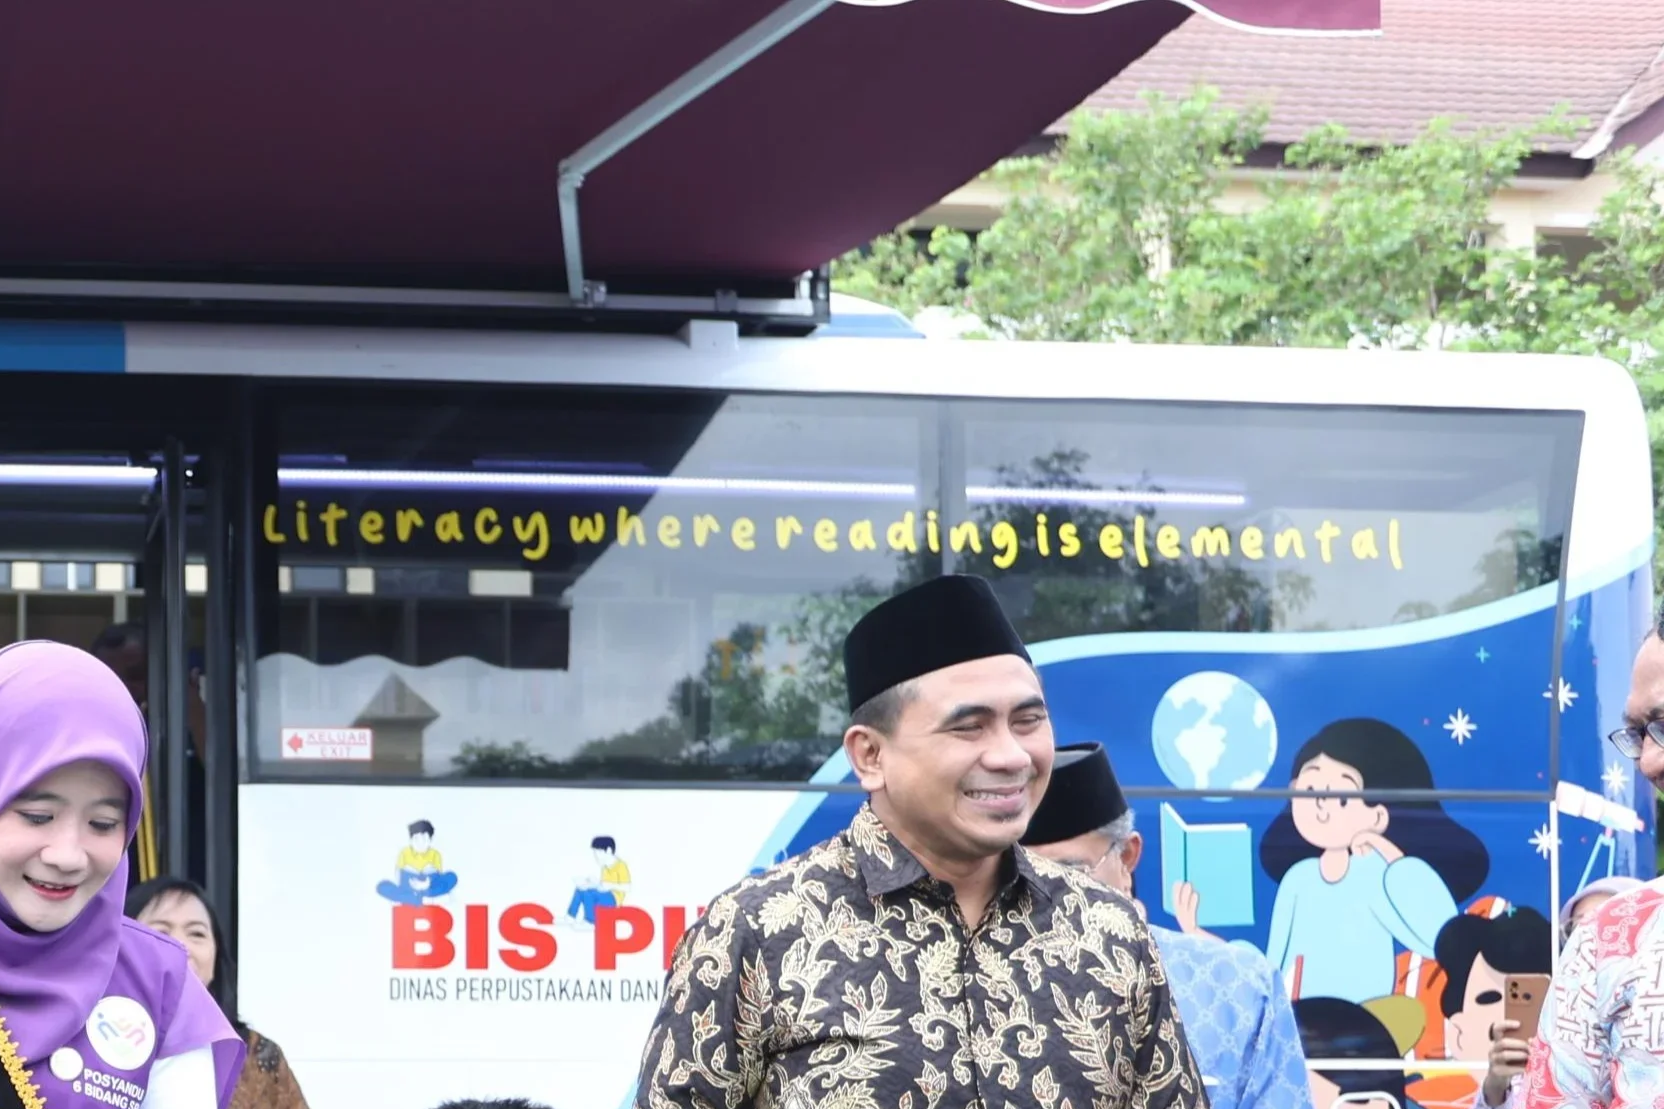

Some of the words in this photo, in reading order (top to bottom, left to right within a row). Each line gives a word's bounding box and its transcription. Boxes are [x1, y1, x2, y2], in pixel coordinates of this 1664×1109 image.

[262, 501, 550, 560] Literacy
[569, 506, 756, 551] where
[775, 511, 1019, 568] reading
[1036, 513, 1081, 557] is
[1098, 514, 1403, 569] elemental
[307, 731, 367, 743] KELUAR
[320, 746, 352, 758] EXIT
[392, 902, 558, 972] BIS
[594, 905, 707, 971] PI
[389, 977, 448, 1001] DINAS
[456, 977, 612, 1002] PERPUSTAKAAN
[620, 979, 658, 1002] DAN
[72, 1080, 82, 1093] 6
[84, 1082, 129, 1109] BIDANG
[83, 1068, 145, 1101] POSYANDU
